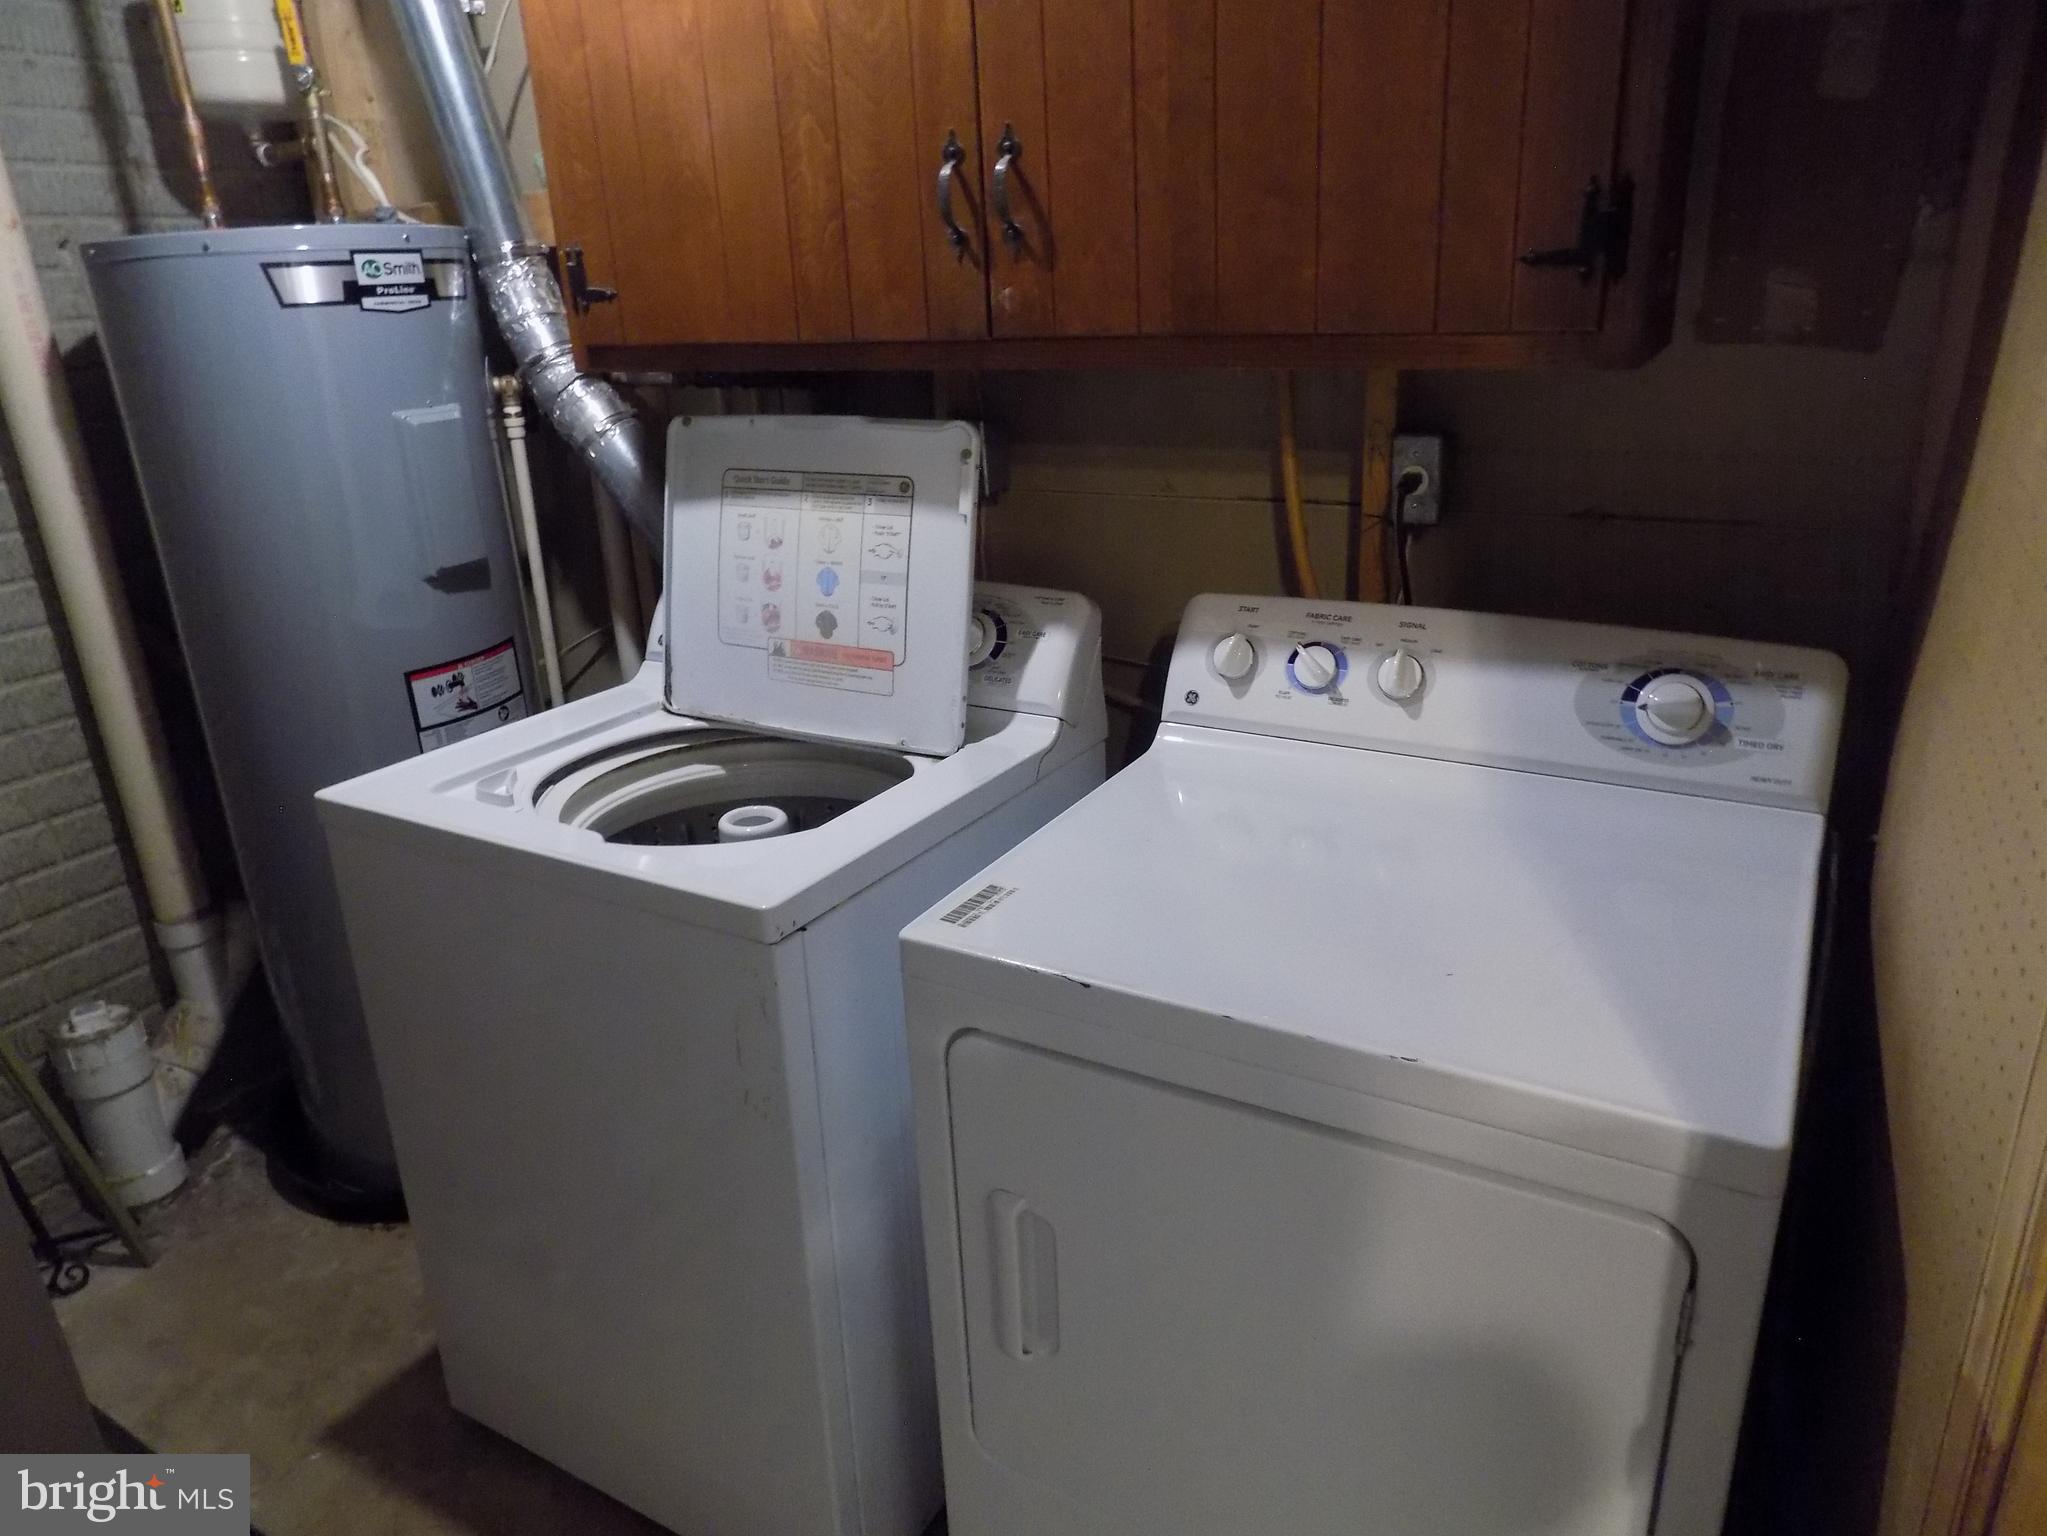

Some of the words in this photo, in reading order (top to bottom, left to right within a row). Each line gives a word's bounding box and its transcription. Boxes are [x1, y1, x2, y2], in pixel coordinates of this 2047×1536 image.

[1238, 605, 1260, 613] START
[1306, 612, 1332, 620] FABRIC
[1333, 614, 1352, 622] CARE
[1398, 621, 1427, 630] SIGNAL
